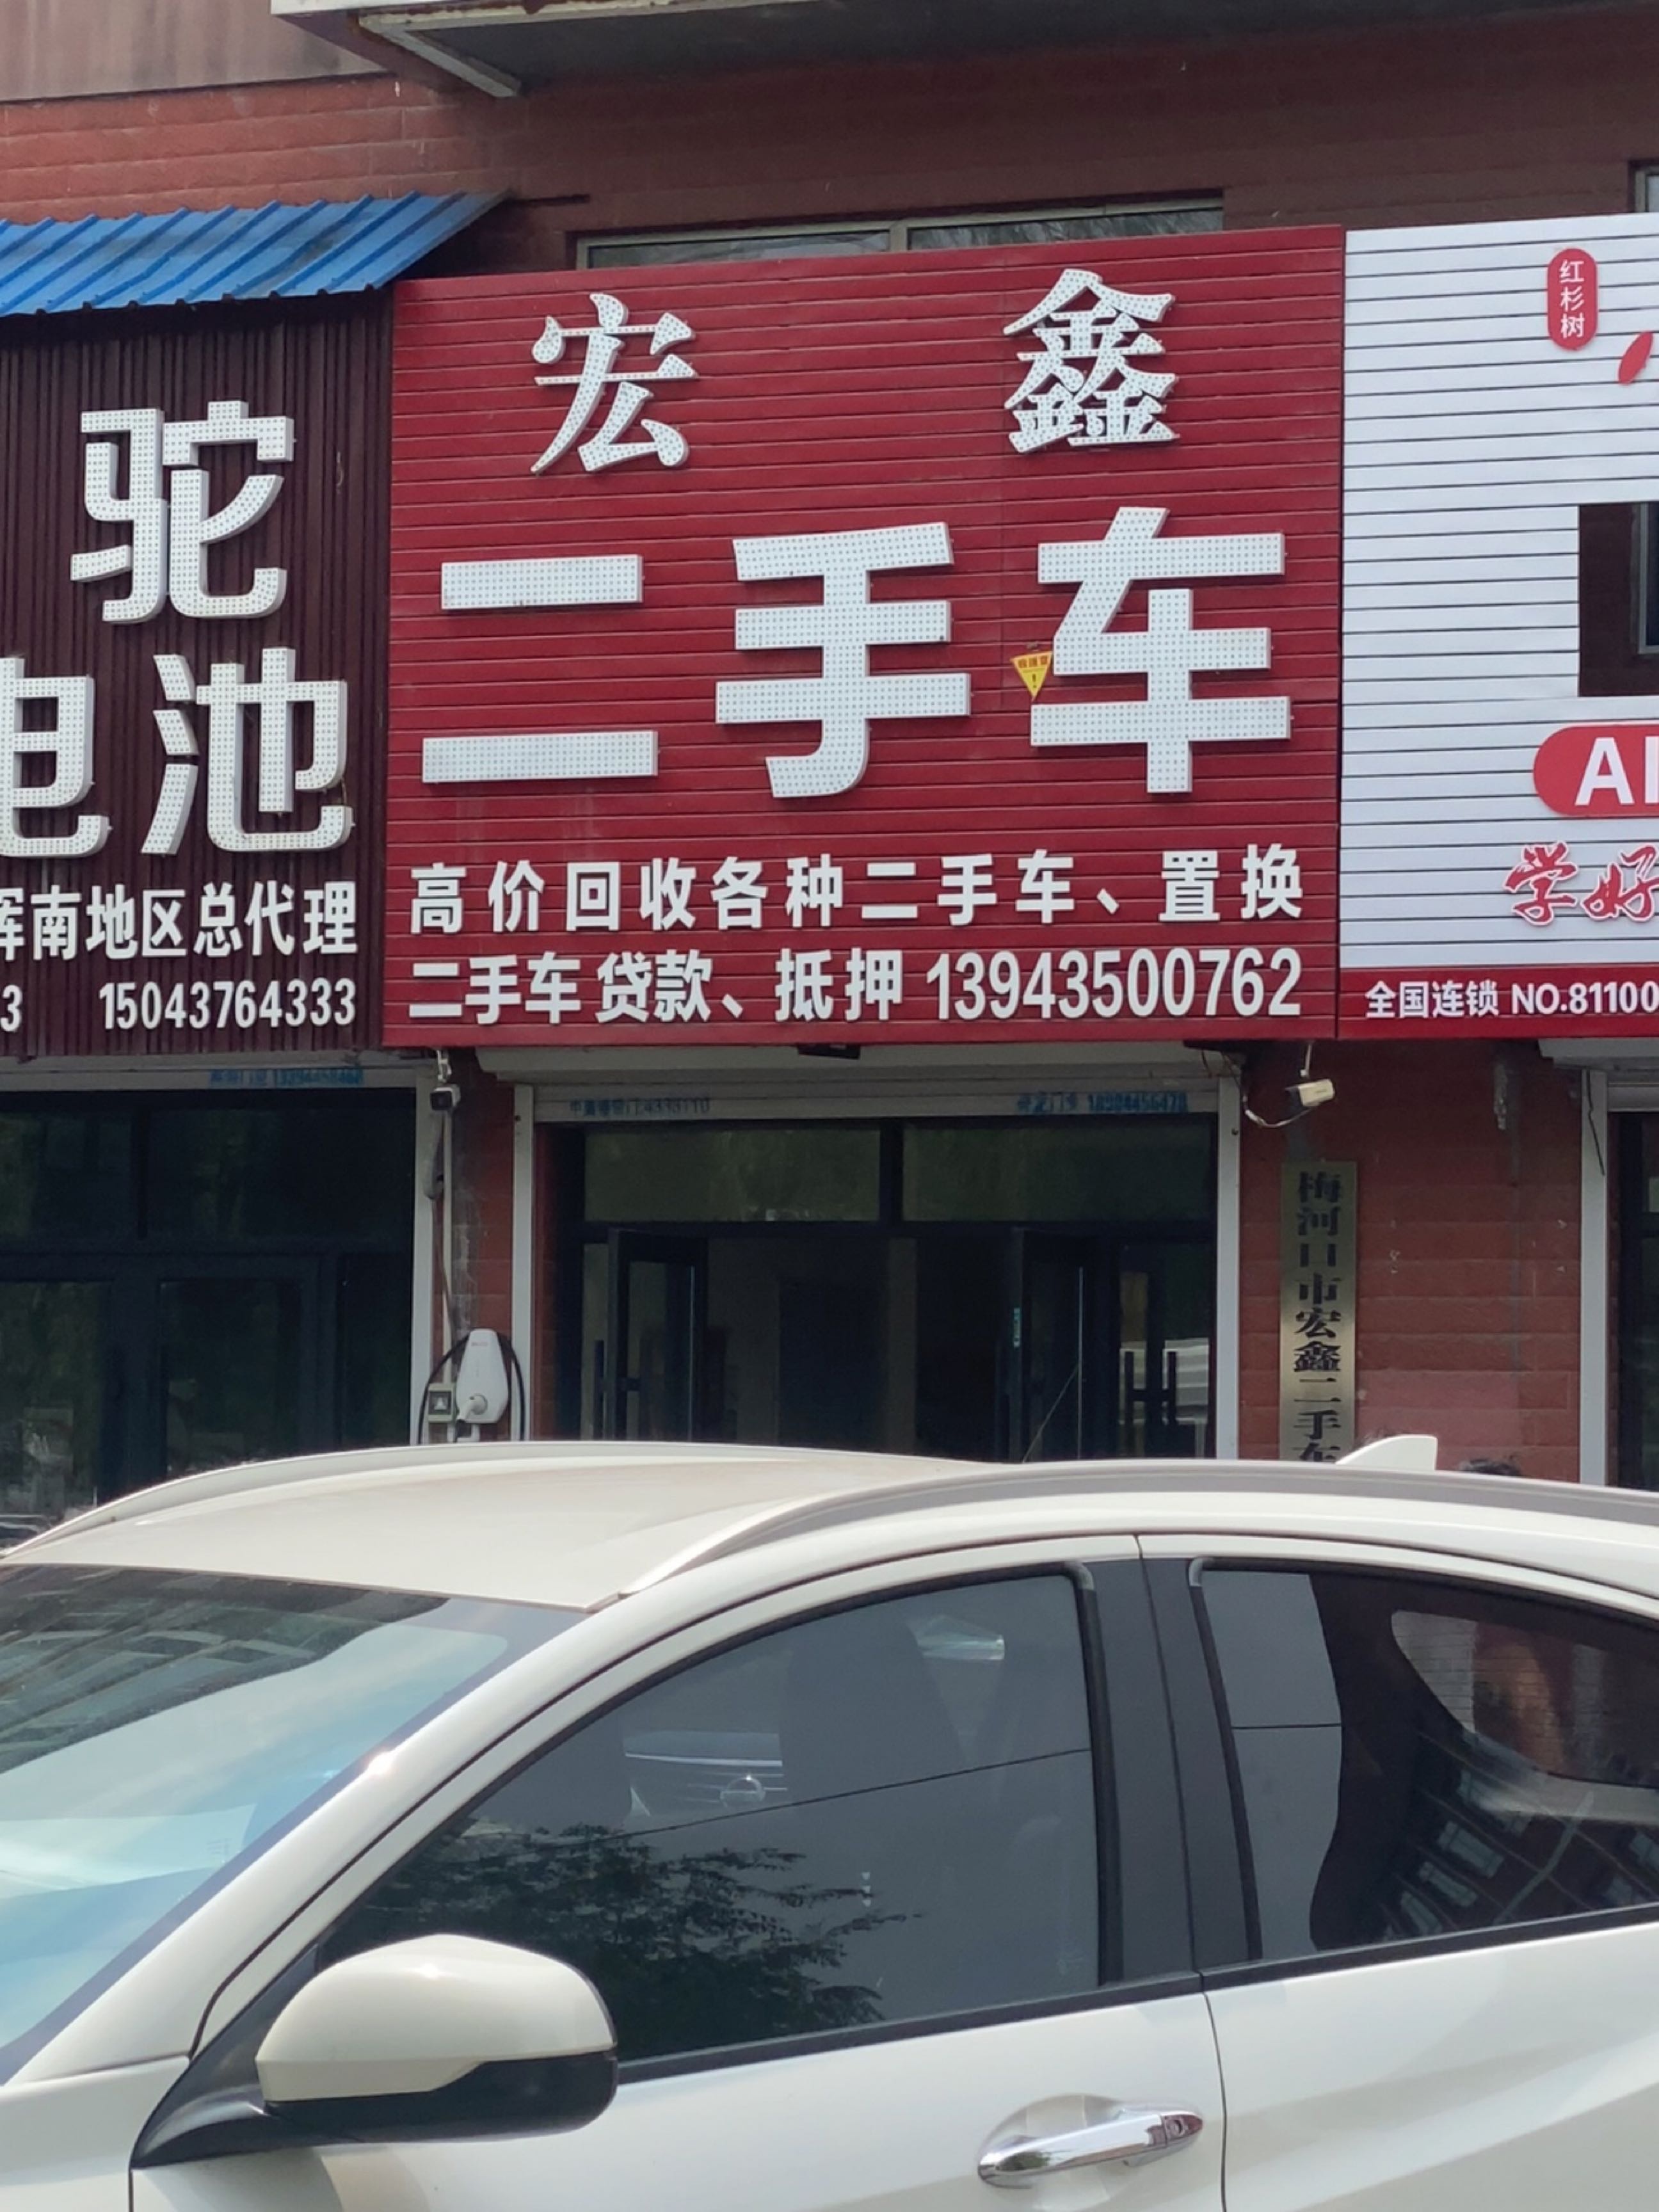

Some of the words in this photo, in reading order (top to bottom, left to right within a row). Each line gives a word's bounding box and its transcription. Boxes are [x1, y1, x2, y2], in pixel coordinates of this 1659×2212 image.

[1559, 260, 1585, 339] 红杉树
[531, 269, 1178, 474] 宏鑫
[70, 401, 295, 621] 驼
[422, 507, 1291, 797] 二手车
[410, 843, 1303, 934] 高价回收各种二手车、置换
[1505, 842, 1659, 926] 学好
[99, 977, 355, 1029] 15043764333
[409, 947, 903, 1025] 二手车贷款、抵押
[927, 947, 1301, 1020] 13943500762
[1365, 979, 1499, 1018] 全国连锁
[1512, 981, 1659, 1014] NO.81100
